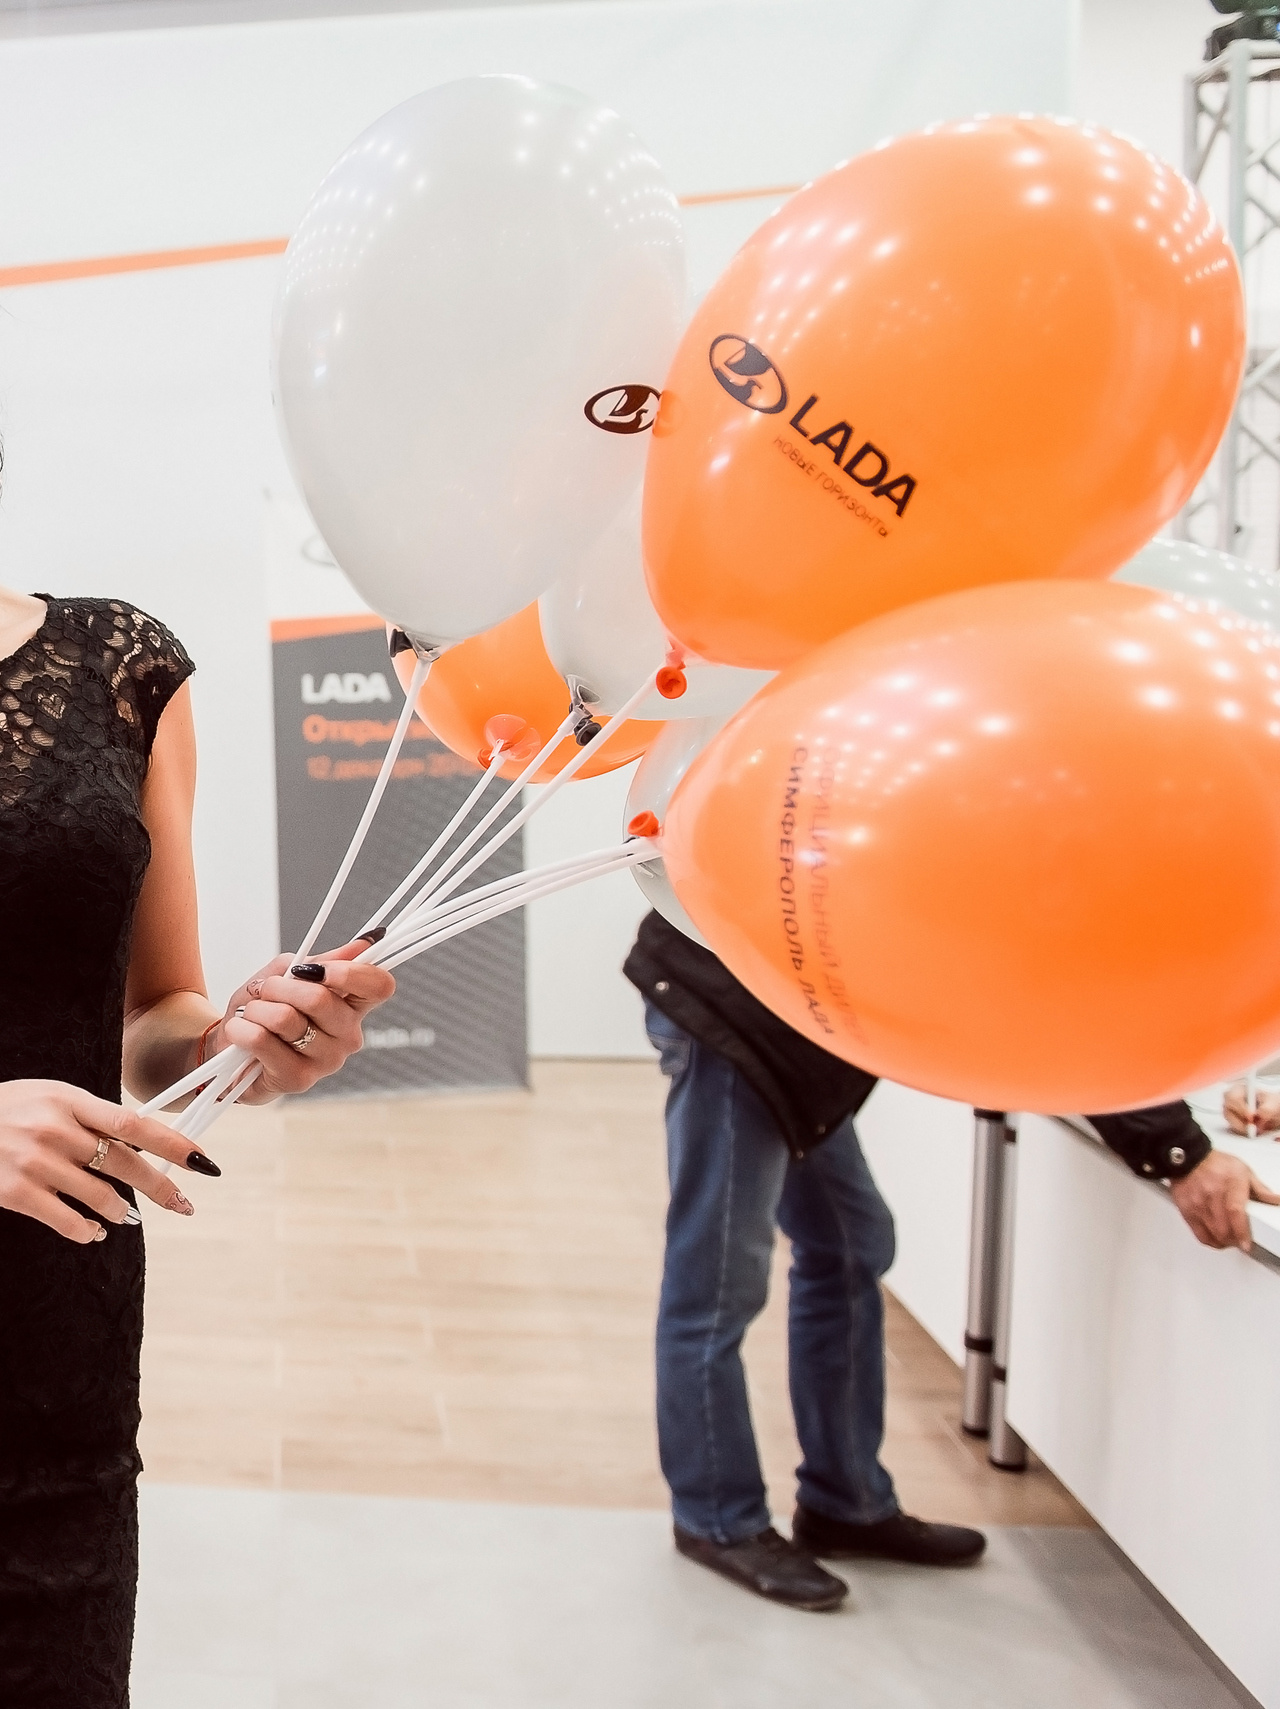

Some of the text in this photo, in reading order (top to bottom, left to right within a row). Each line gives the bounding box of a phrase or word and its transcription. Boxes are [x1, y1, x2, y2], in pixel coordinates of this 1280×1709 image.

[773, 435, 890, 538] НОВЫЕ ГОРИЗОНТЫ
[789, 394, 919, 517] LADA
[301, 672, 392, 704] LADA
[780, 746, 835, 1035] СИМФЕРОПОЛЬ ЛАДА
